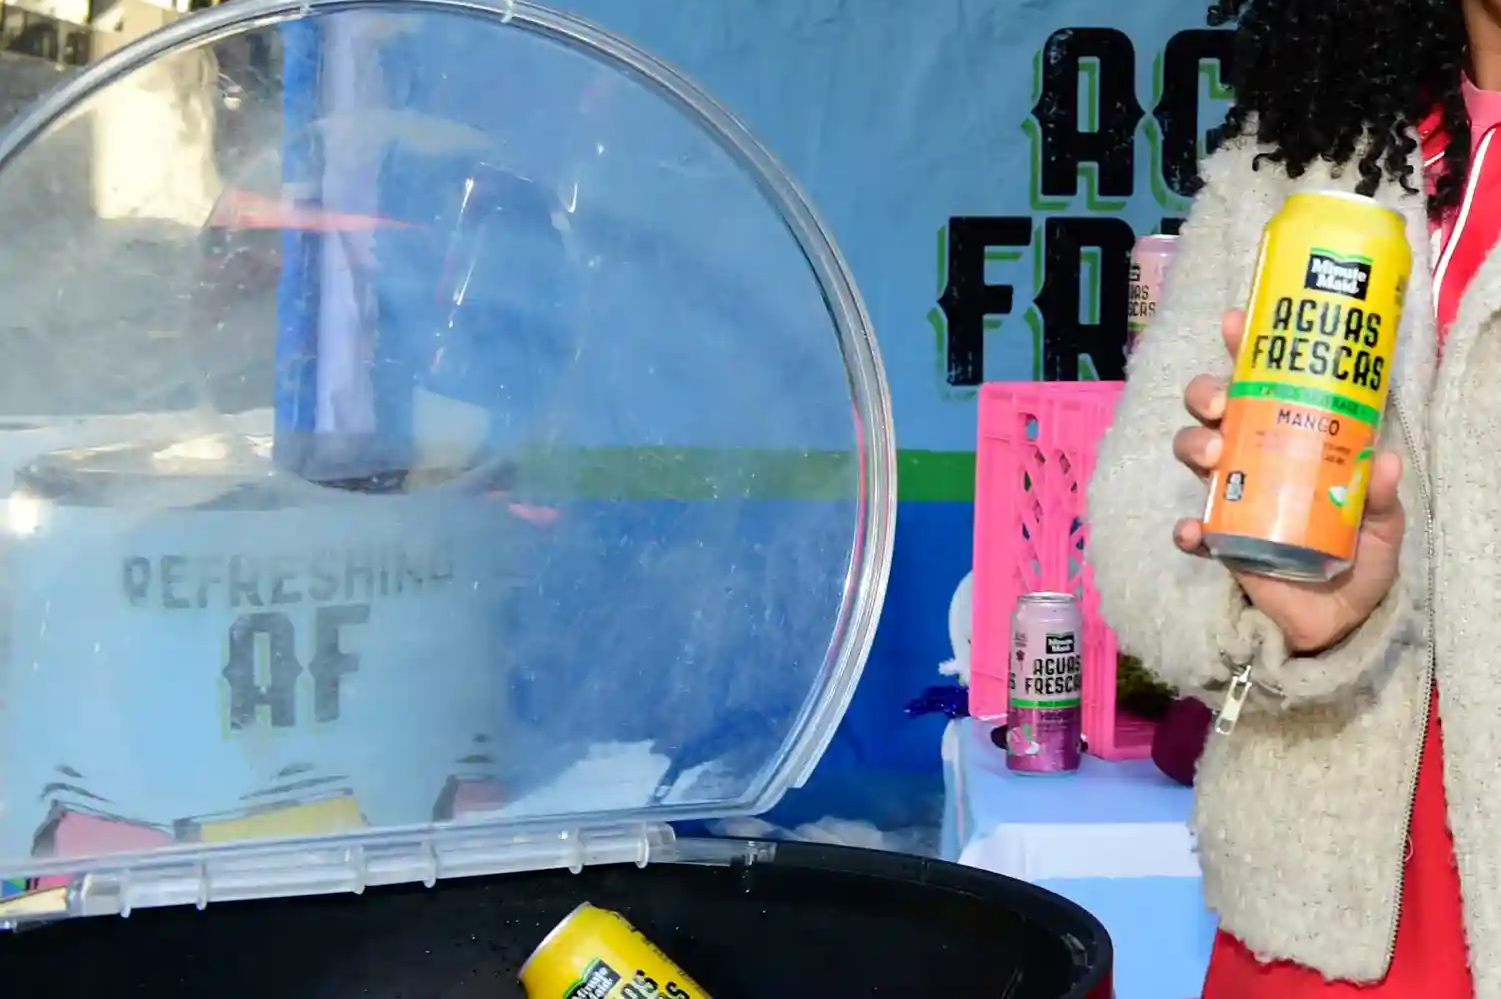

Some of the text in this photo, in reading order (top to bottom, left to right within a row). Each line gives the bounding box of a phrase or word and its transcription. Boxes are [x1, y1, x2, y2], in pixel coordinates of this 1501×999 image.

[1272, 297, 1382, 349] AGUAS
[1251, 335, 1385, 392] FRESCAS
[1277, 408, 1341, 436] MANGO
[217, 604, 371, 741] AF
